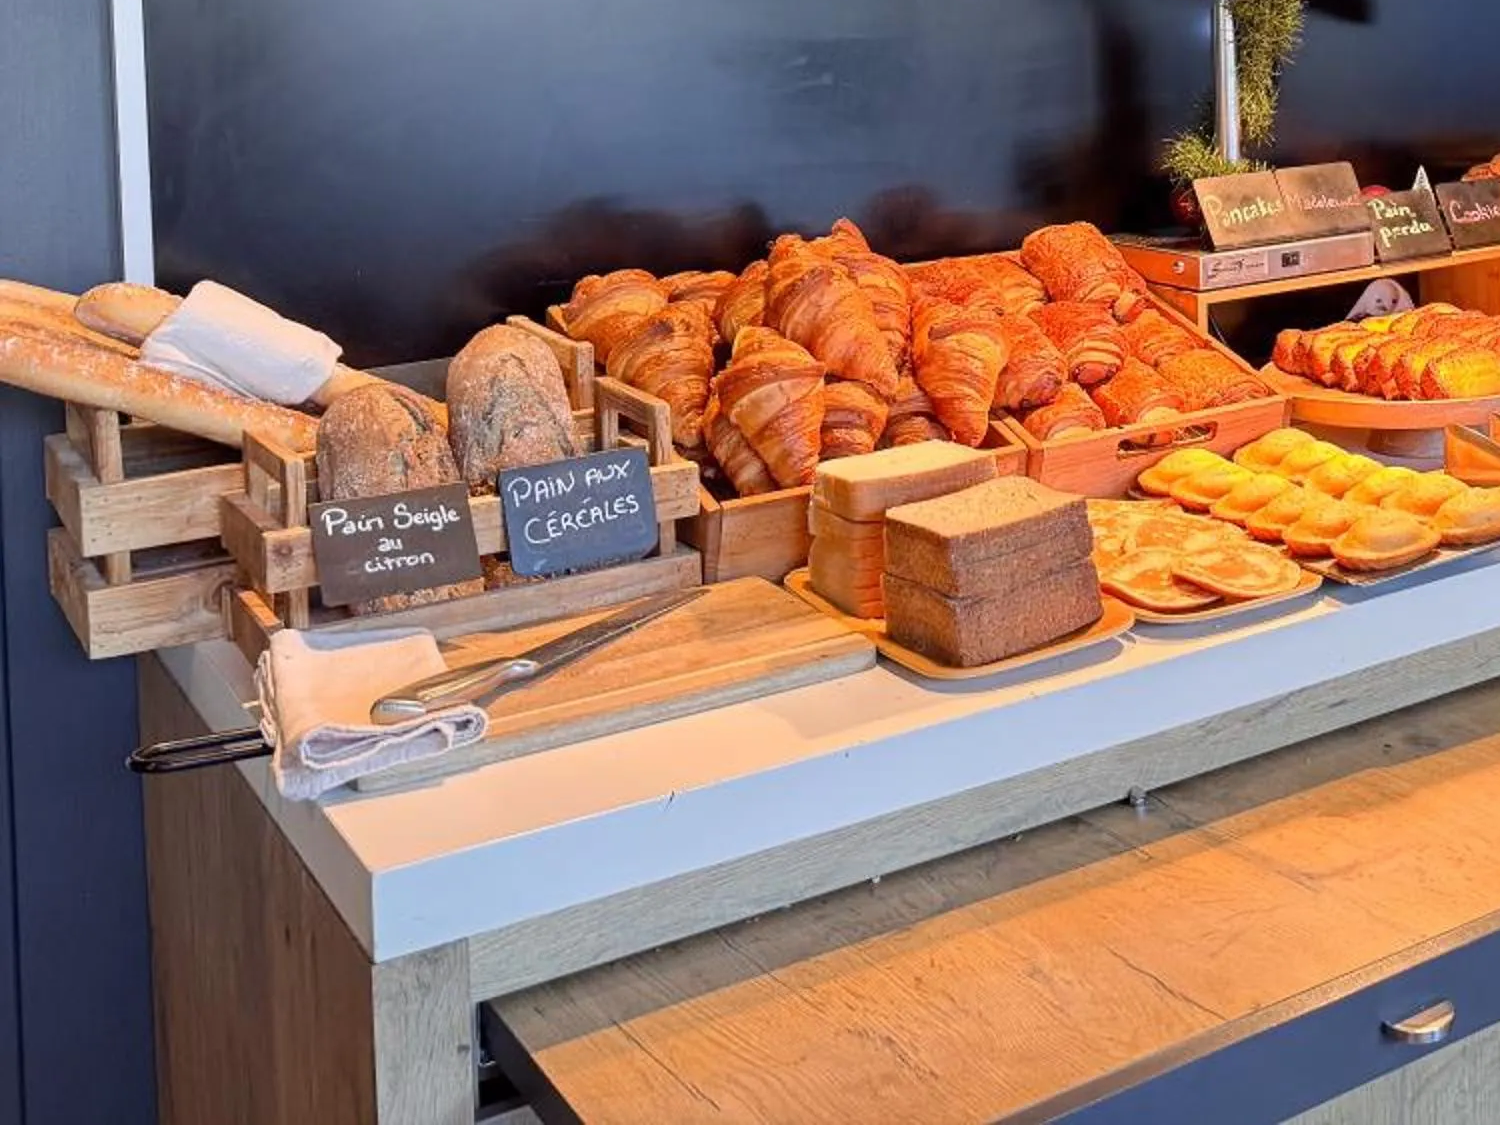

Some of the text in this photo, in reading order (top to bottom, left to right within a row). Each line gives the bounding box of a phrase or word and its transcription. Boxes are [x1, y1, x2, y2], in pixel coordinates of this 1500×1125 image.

[1367, 198, 1416, 220] Pain
[1379, 219, 1434, 248] perdu
[584, 458, 631, 487] AUX
[321, 502, 460, 536] Pain Seigle
[524, 494, 640, 544] CÉRÉALES
[378, 537, 403, 552] au
[364, 552, 436, 573] citron
